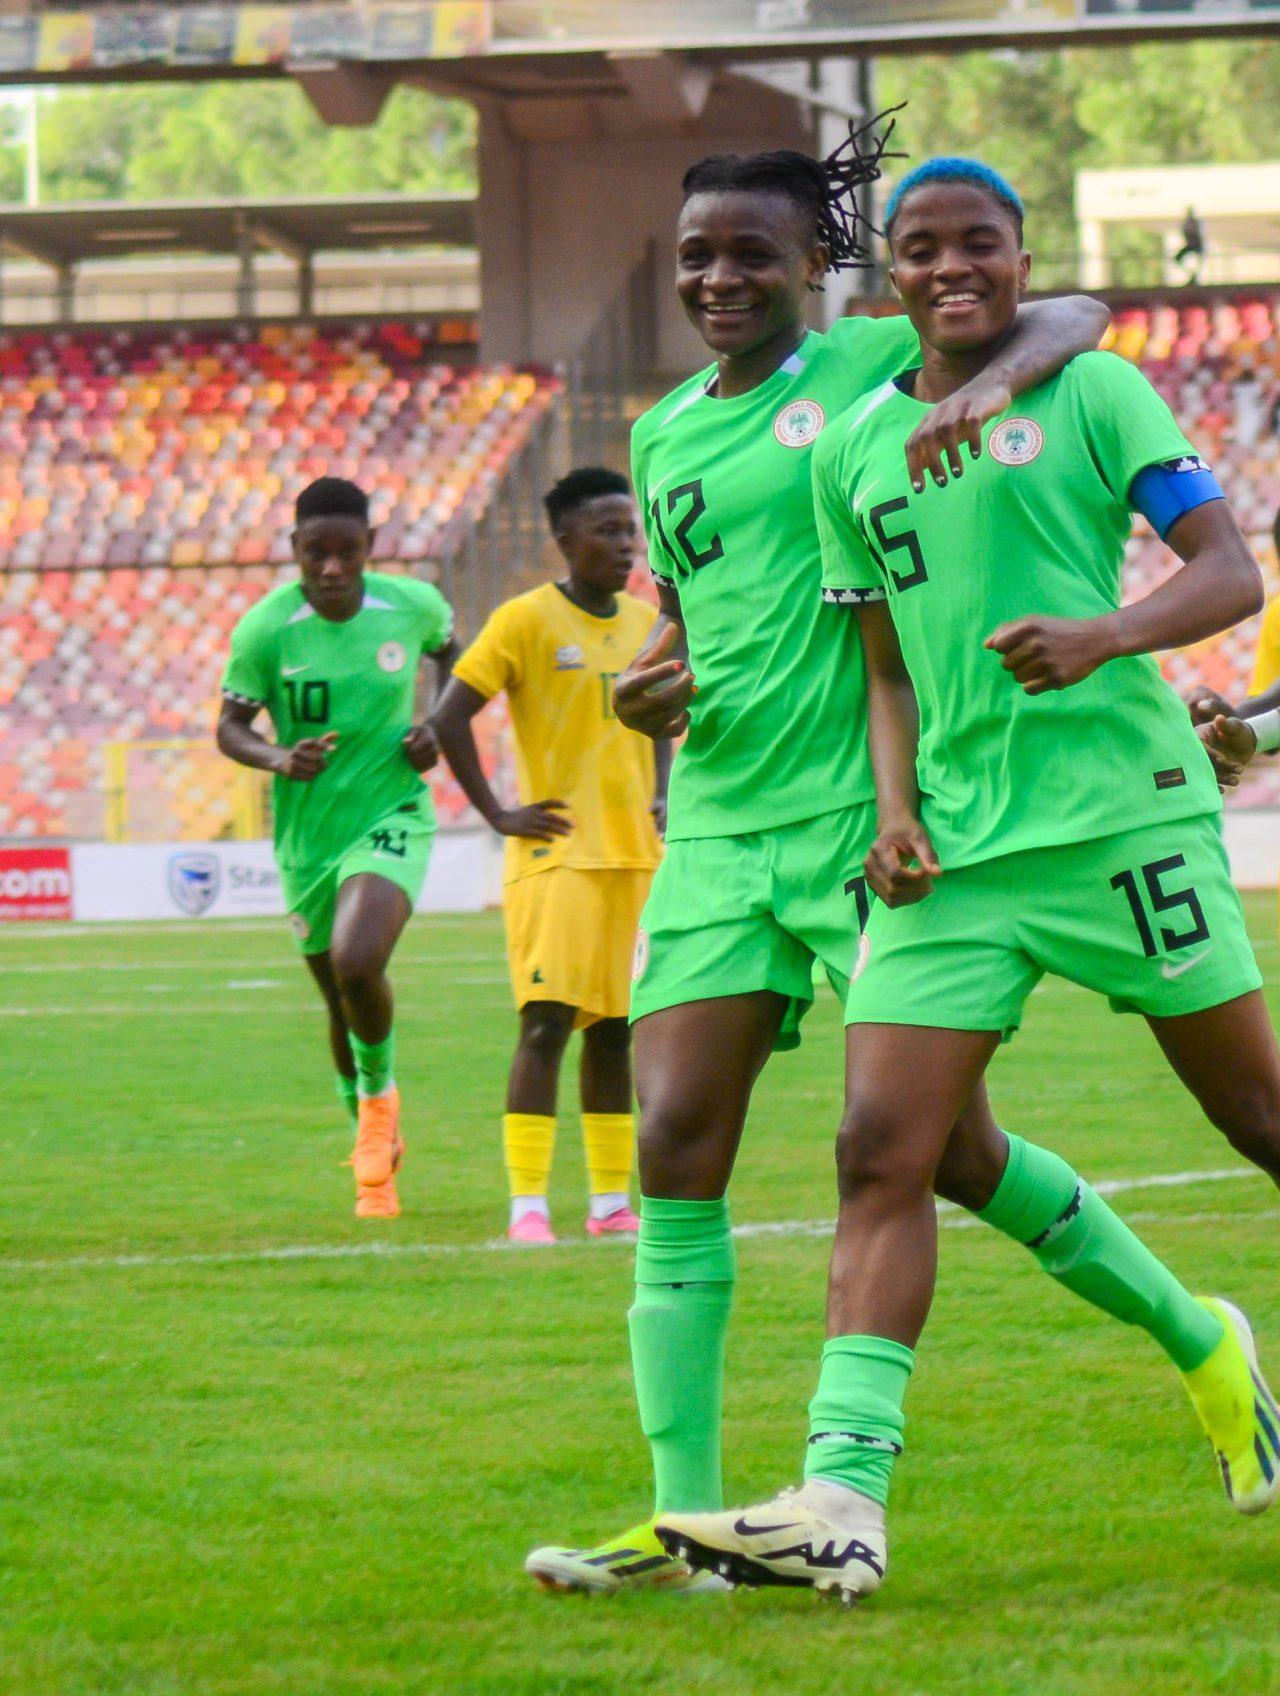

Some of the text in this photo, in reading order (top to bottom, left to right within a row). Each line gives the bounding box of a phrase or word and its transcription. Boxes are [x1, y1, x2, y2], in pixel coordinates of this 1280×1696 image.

[652, 478, 725, 577] 12
[284, 681, 330, 724] 10
[1109, 852, 1210, 958] 15
